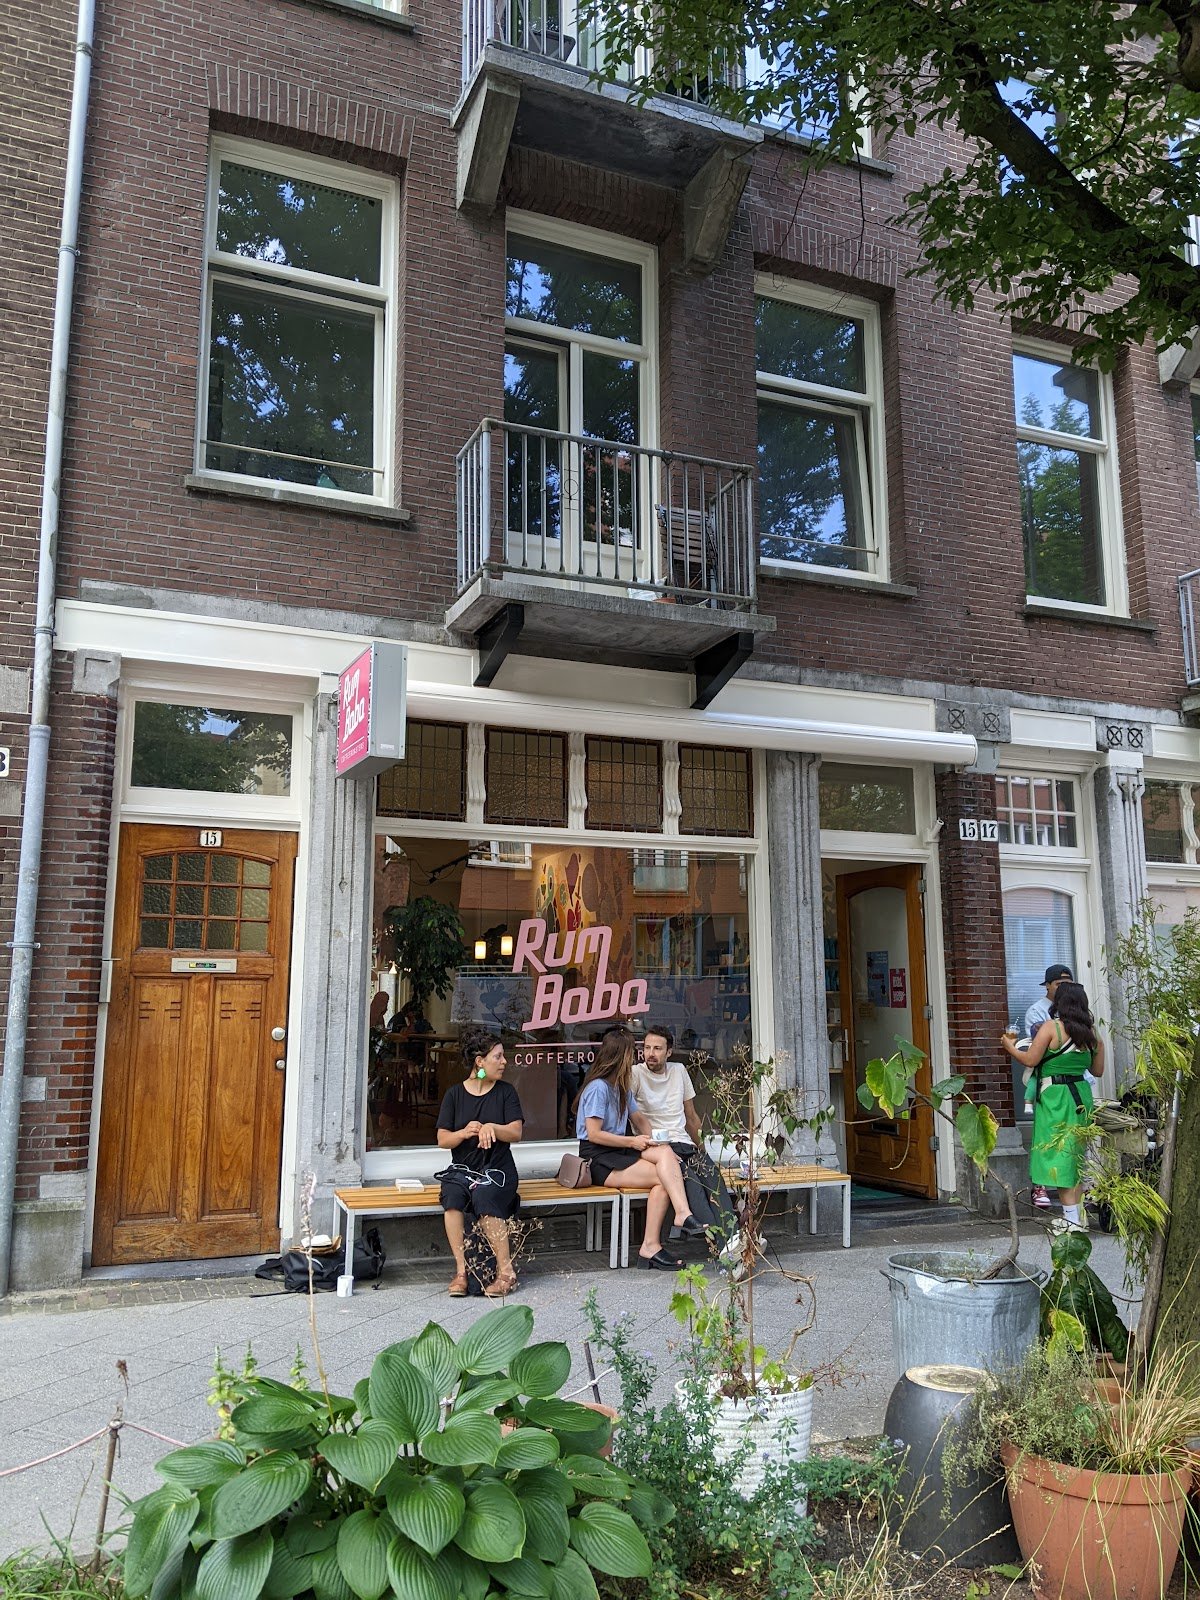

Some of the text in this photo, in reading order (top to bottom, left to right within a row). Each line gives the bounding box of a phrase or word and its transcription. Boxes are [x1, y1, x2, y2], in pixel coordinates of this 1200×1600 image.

[342, 669, 360, 710] Rum
[342, 697, 365, 743] Baba
[204, 831, 217, 846] 15
[961, 822, 976, 838] 15
[982, 823, 996, 838] 17
[512, 918, 613, 973] Rum
[521, 974, 650, 1031] Baba
[514, 1051, 645, 1065] COFFEEROR
